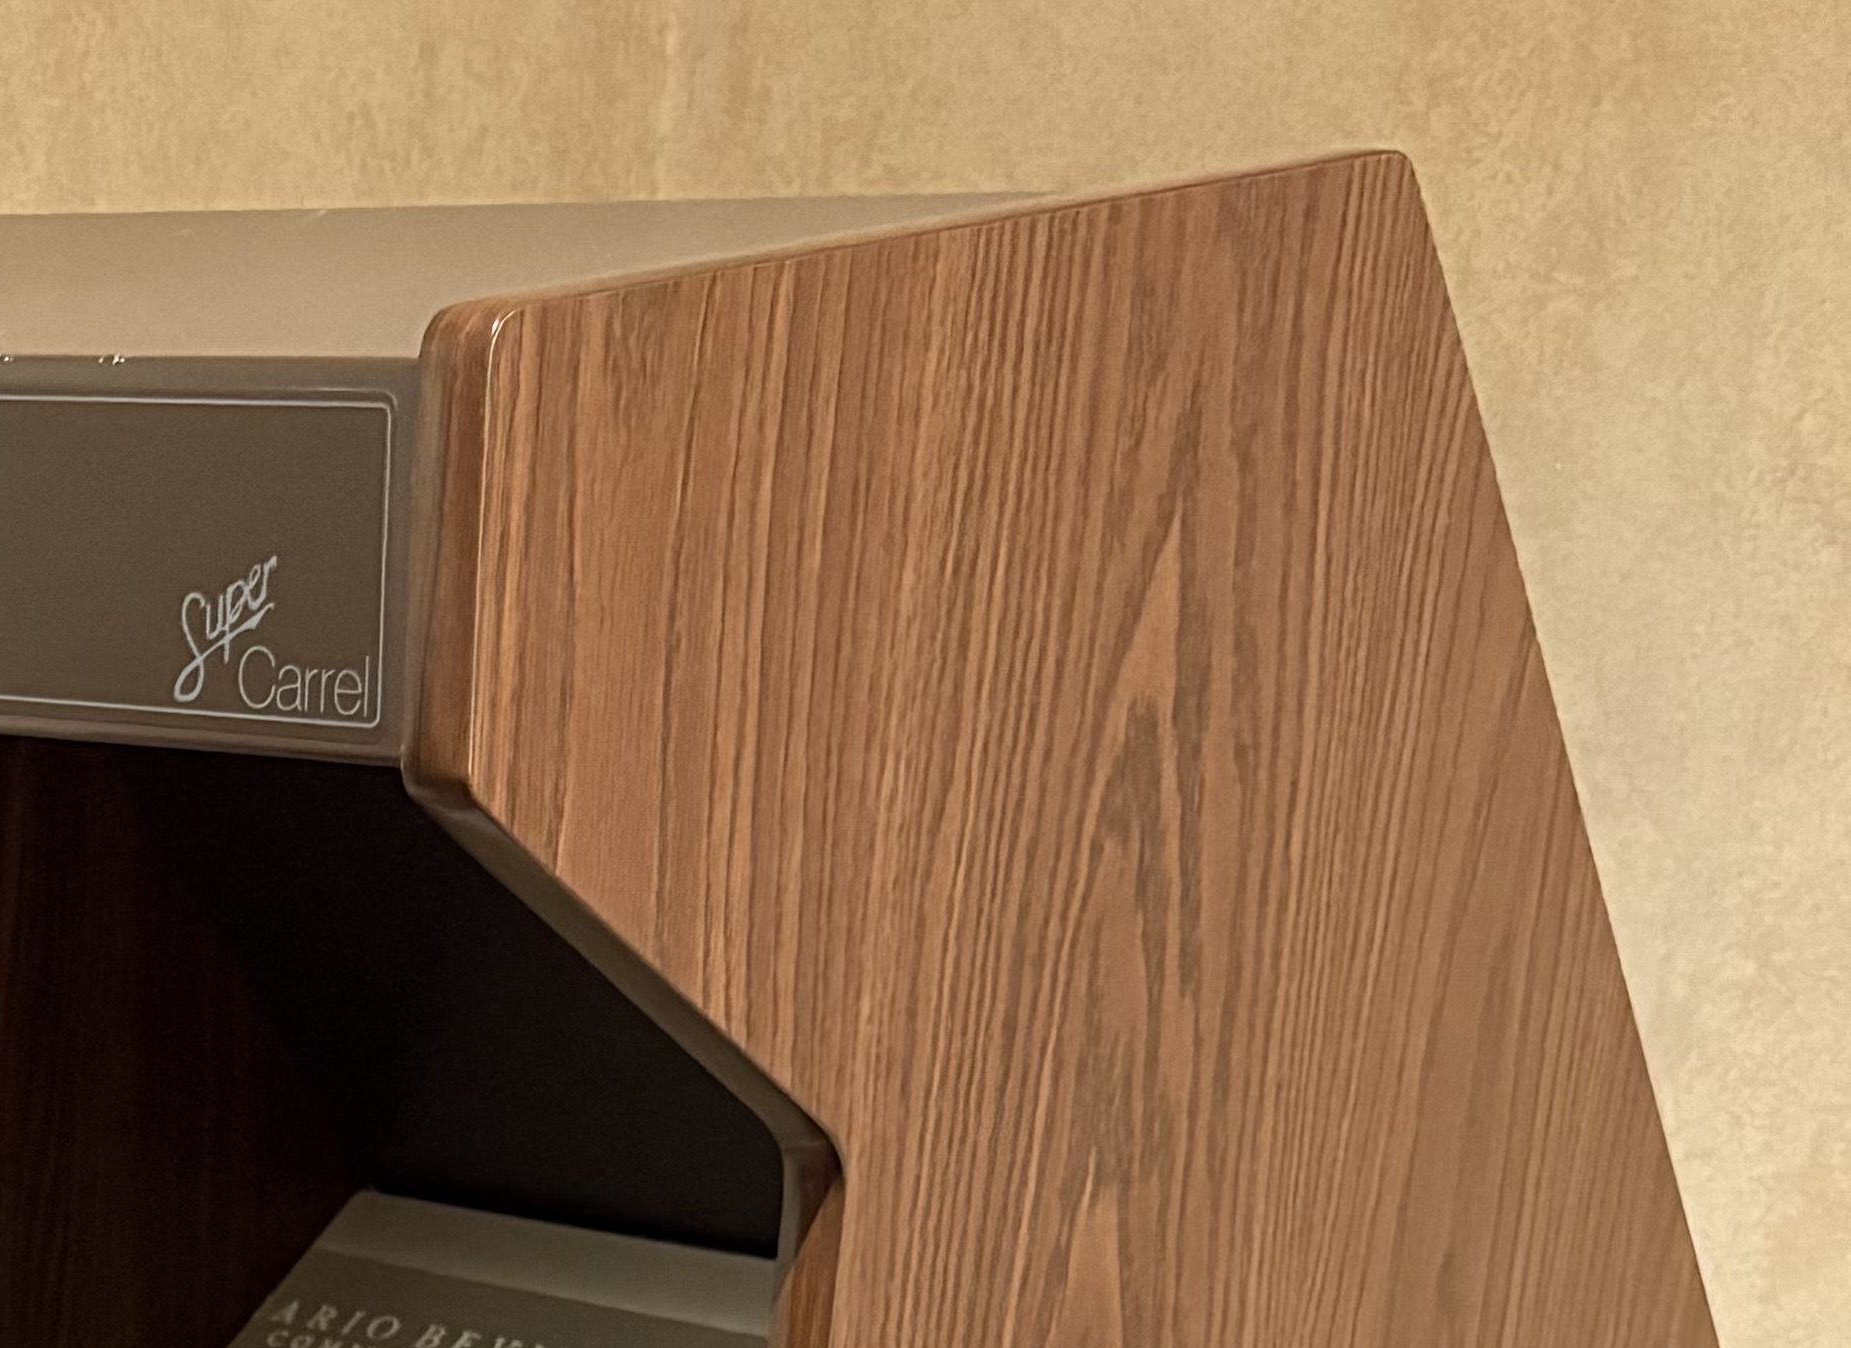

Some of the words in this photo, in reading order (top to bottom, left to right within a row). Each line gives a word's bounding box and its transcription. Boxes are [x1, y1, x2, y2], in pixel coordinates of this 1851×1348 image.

[173, 555, 277, 702] Super
[238, 645, 370, 717] Carrel
[271, 1301, 400, 1339] ARIO
